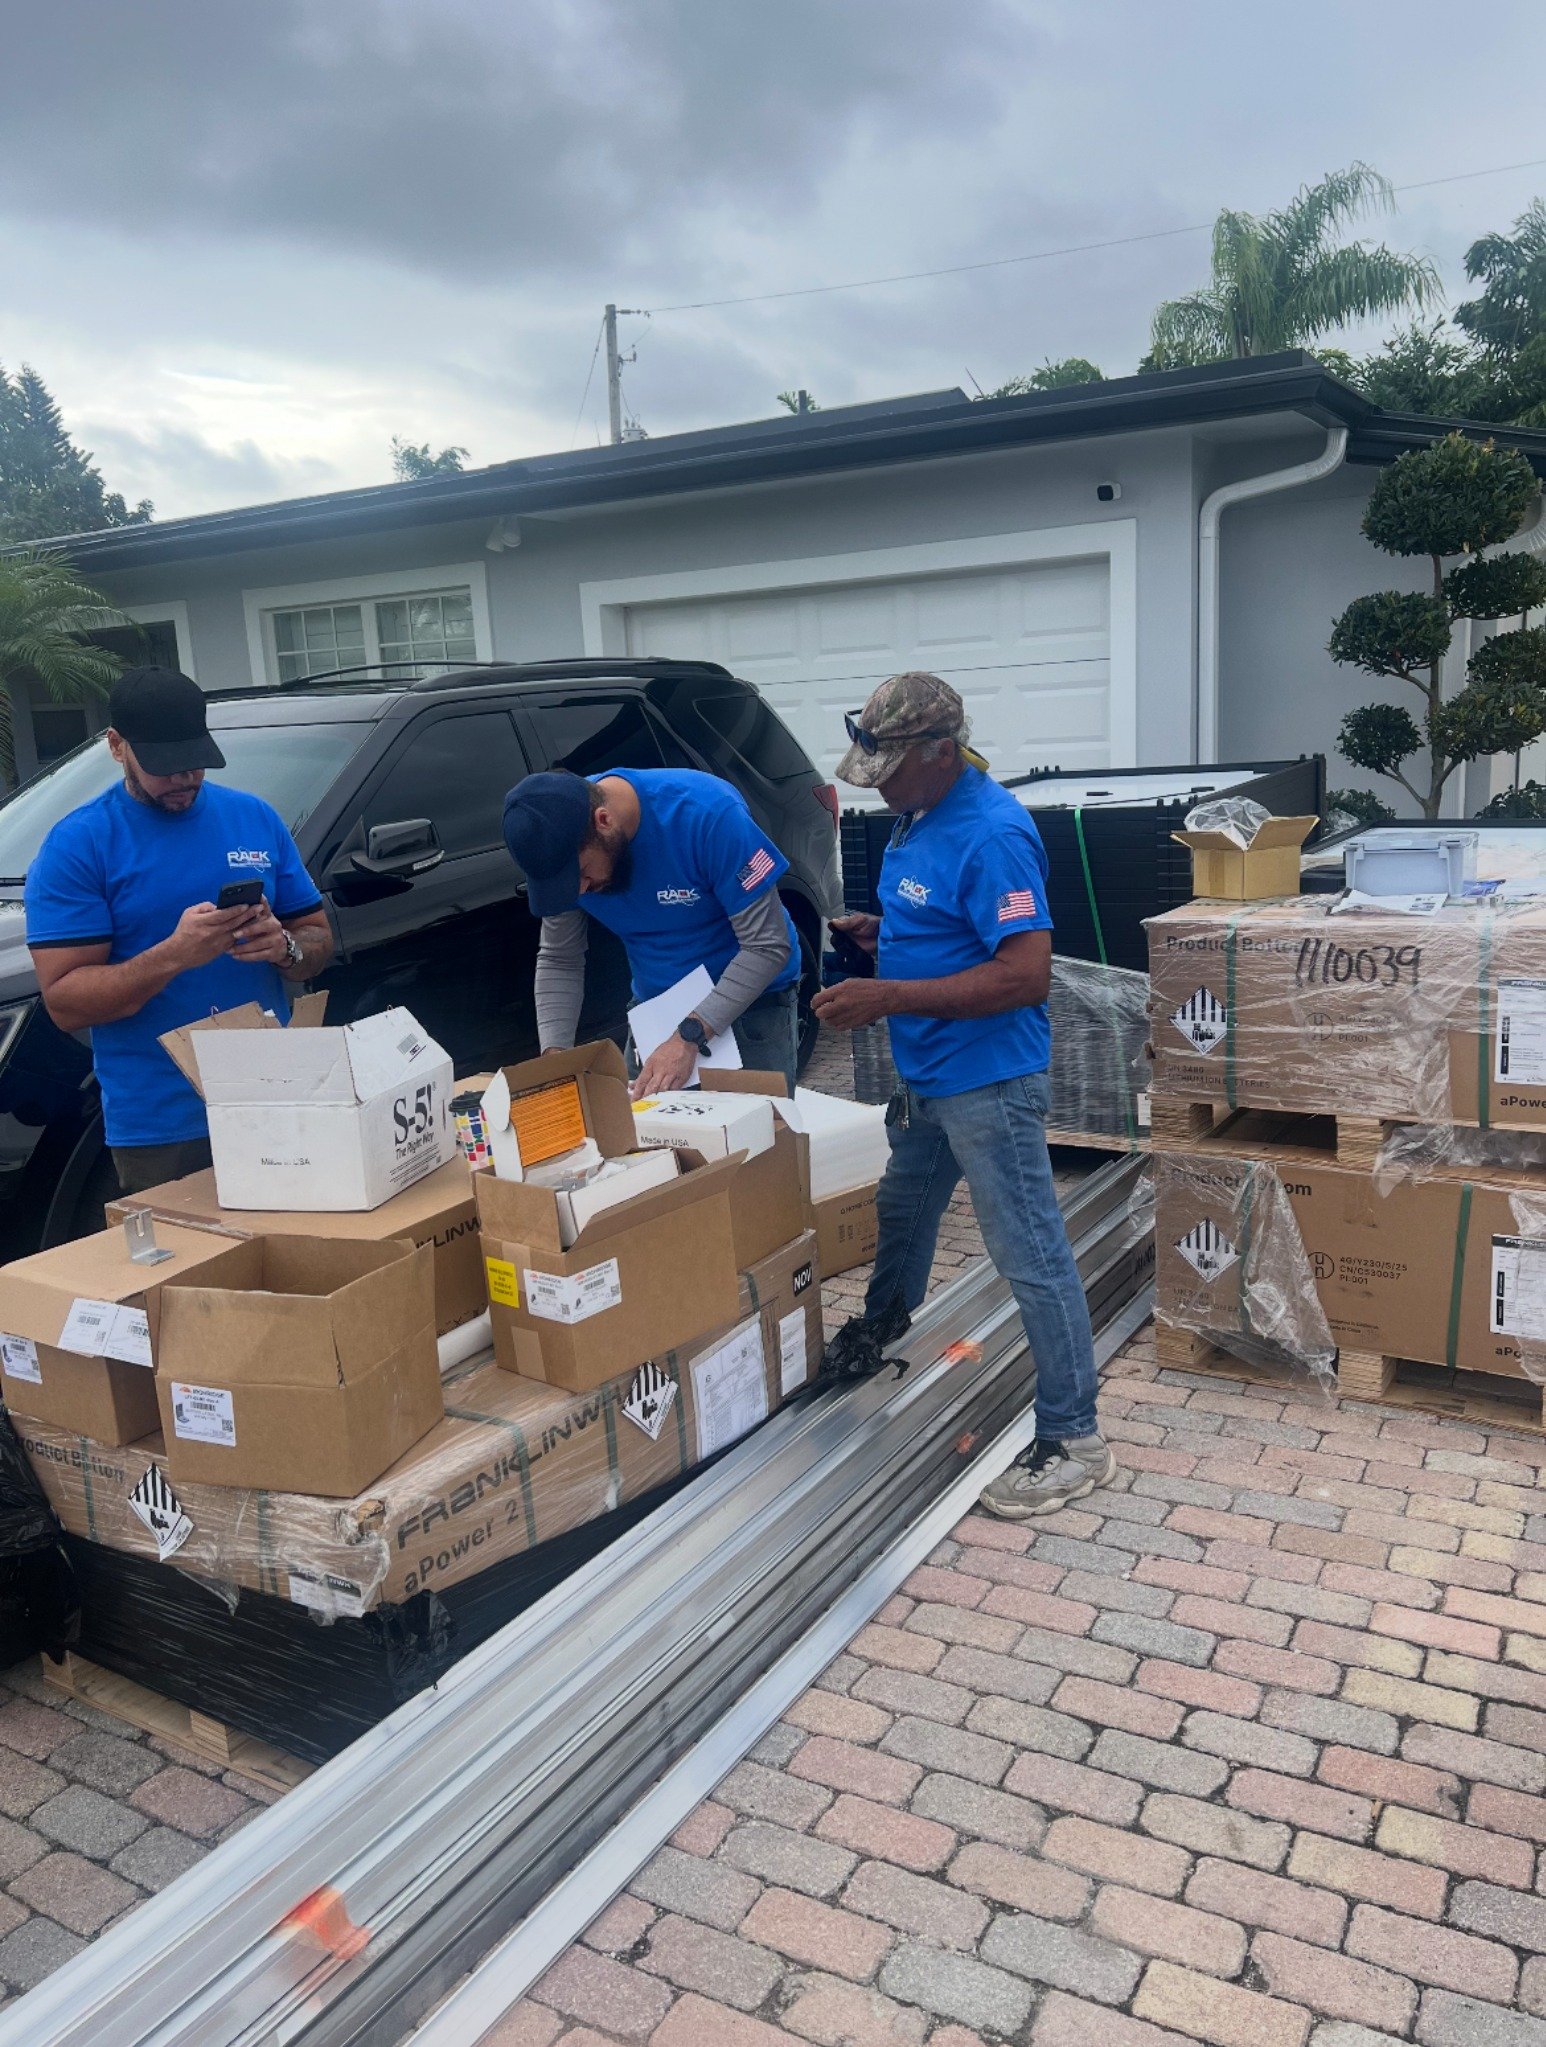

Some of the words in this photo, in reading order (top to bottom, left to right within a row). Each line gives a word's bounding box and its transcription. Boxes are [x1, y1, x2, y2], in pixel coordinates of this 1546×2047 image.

[657, 889, 698, 902] RACK
[1167, 936, 1237, 952] Produc
[1222, 1079, 1271, 1089] BTTERIES
[394, 1084, 433, 1146] S-5!
[641, 1136, 662, 1145] Made
[663, 1138, 671, 1146] in
[671, 1138, 689, 1147] USA
[794, 1268, 812, 1292] NOV
[71, 1451, 126, 1483] Bttom
[404, 1516, 495, 1594] aPower
[504, 1498, 519, 1525] 2
